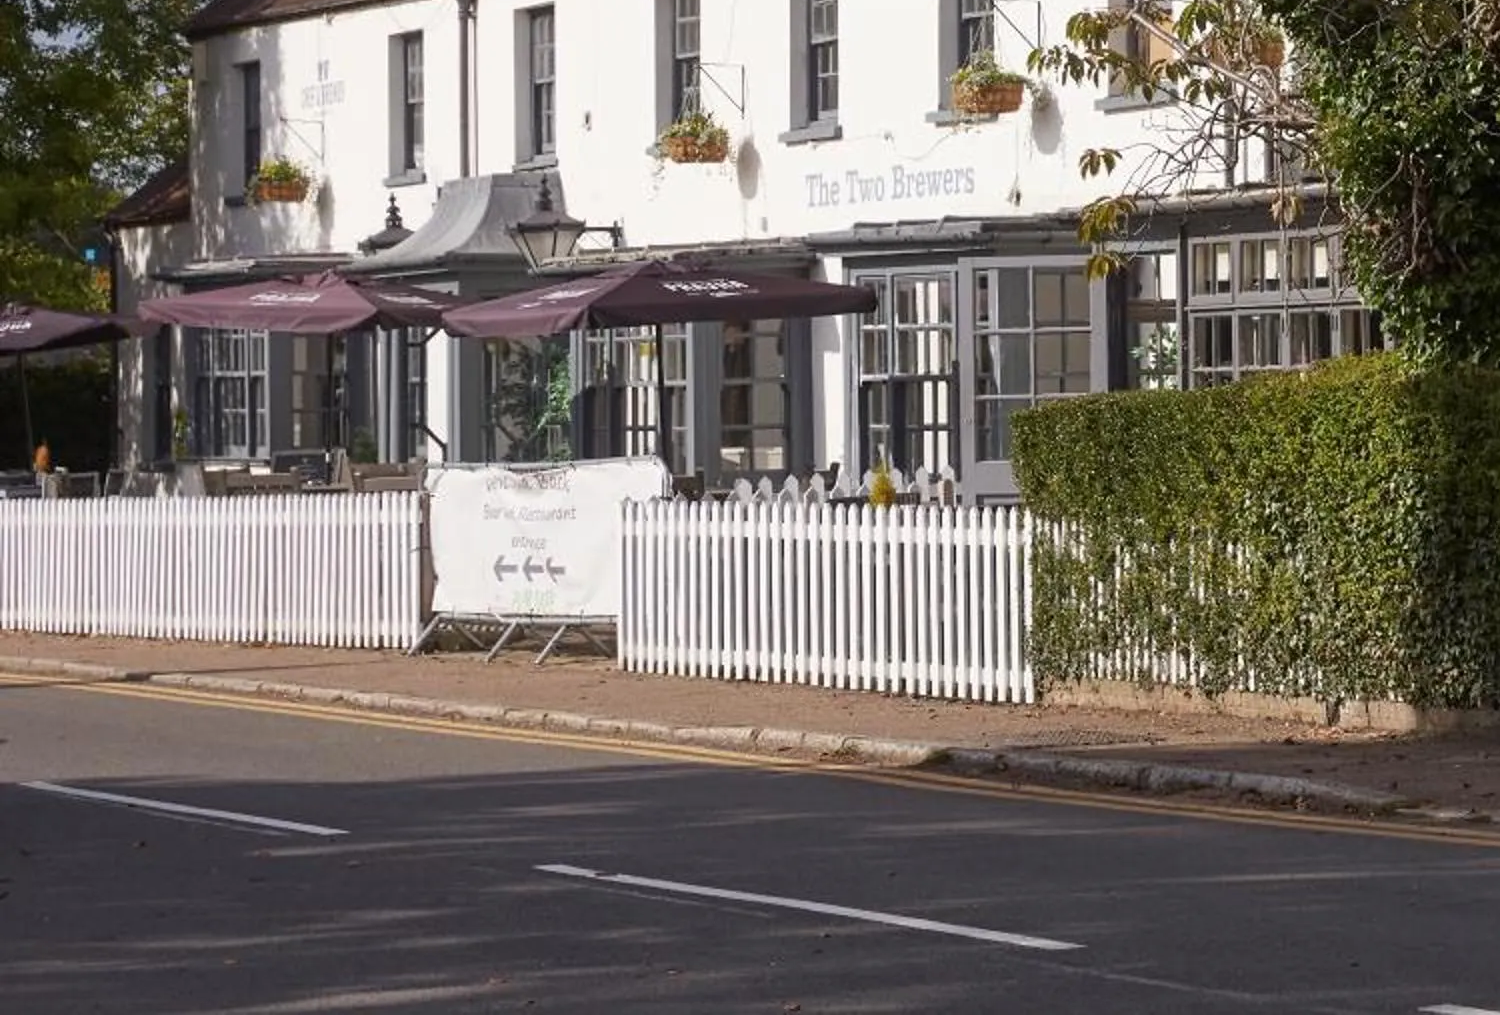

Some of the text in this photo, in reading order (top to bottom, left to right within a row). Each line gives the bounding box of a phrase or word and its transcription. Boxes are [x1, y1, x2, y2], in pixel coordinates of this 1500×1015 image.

[805, 164, 976, 207] The Two Brewers
